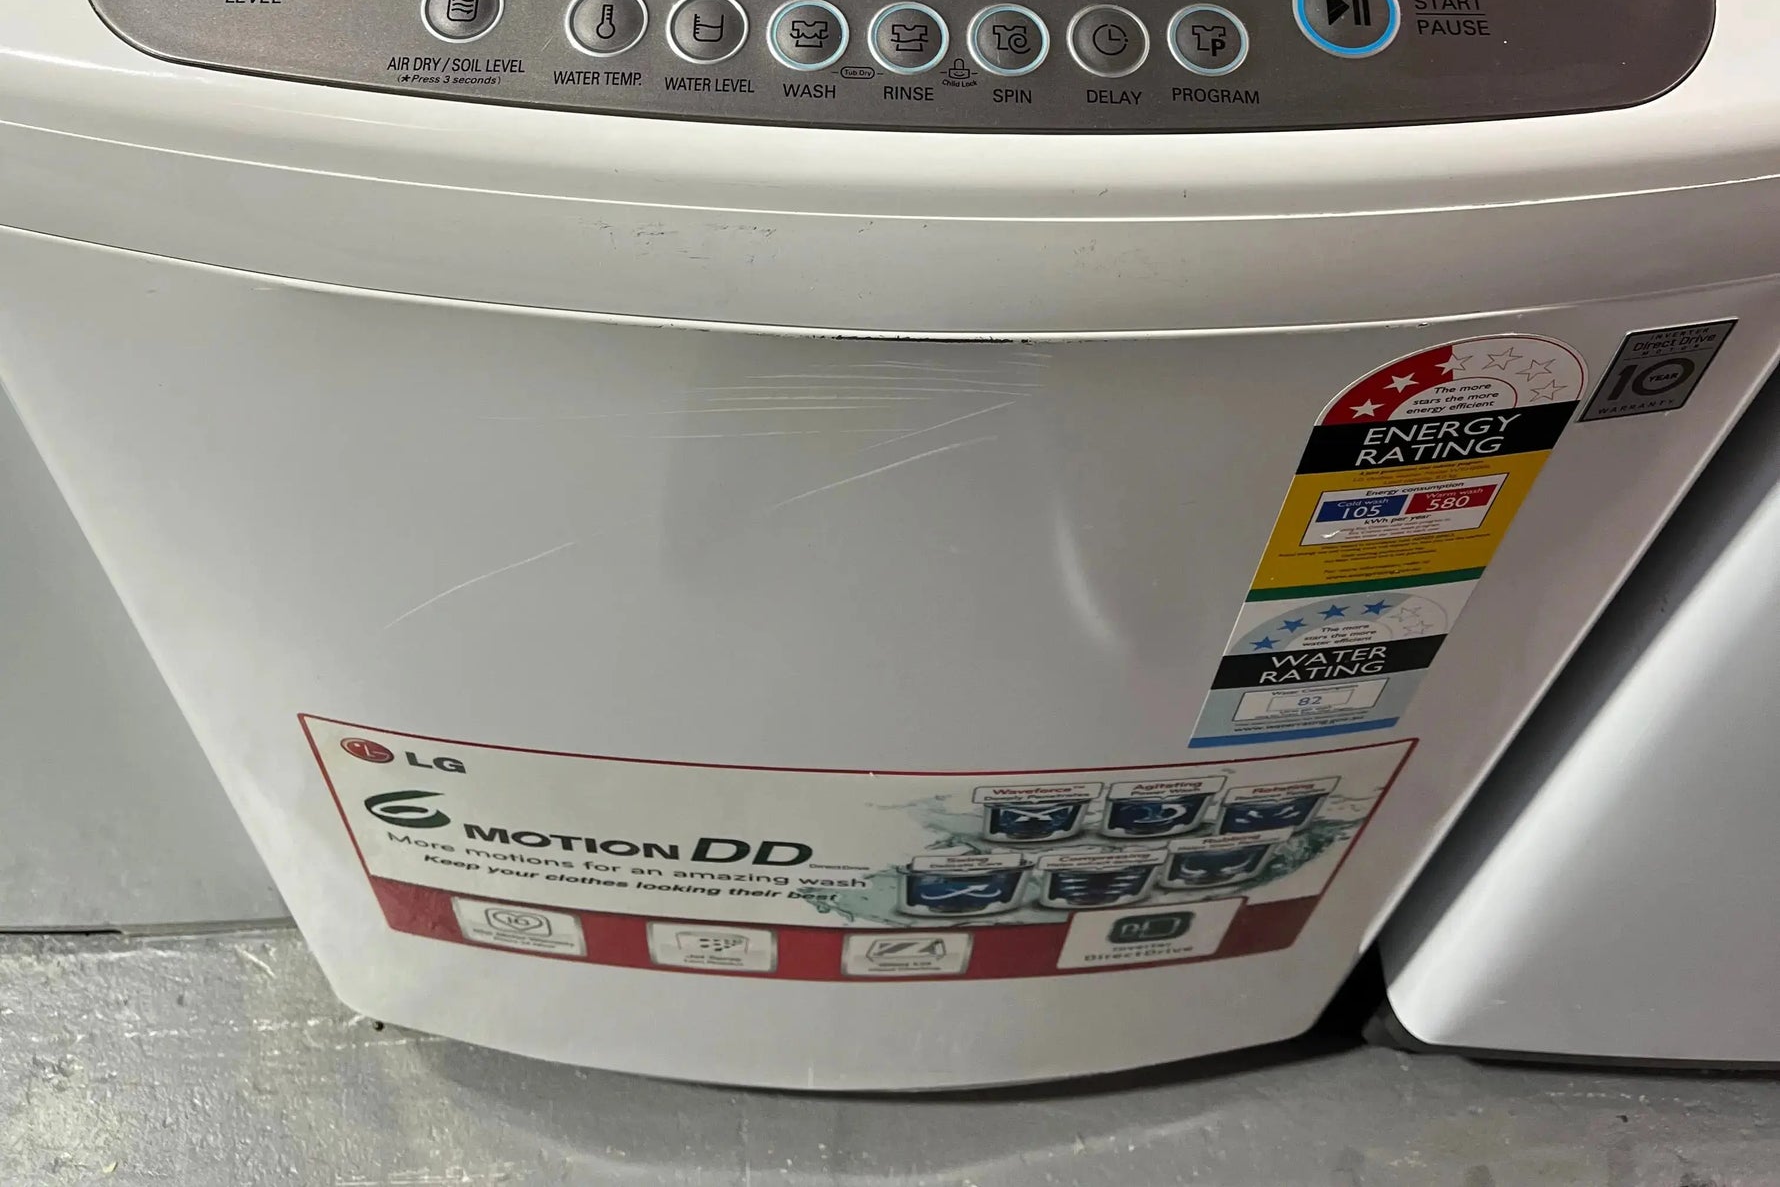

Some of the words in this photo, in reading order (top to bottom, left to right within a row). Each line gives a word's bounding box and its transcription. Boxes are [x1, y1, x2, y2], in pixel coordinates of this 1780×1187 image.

[1416, 19, 1491, 36] PAUSE
[387, 57, 411, 72] AIR
[413, 57, 440, 73] DRY
[452, 58, 483, 73] SOIL
[485, 59, 526, 74] LEVEL
[844, 68, 858, 77] Tub
[858, 68, 872, 79] Dry
[443, 75, 451, 84] 3
[553, 70, 600, 86] WATER
[603, 71, 642, 87] TEMP.
[664, 76, 712, 92] WATER
[714, 77, 755, 94] LEVEL
[942, 78, 960, 88] Child
[961, 78, 978, 88] Lock
[782, 83, 836, 99] WASH
[883, 85, 935, 102] RINSE
[992, 88, 1033, 105] SPIN
[1086, 89, 1143, 106] DELAY
[1171, 87, 1260, 105] PROGRAM
[1650, 327, 1710, 340] INVERTER
[1632, 340, 1677, 352] Direct
[1678, 333, 1717, 346] Drive
[1649, 372, 1679, 383] YEAR
[1434, 386, 1457, 395] The
[1461, 382, 1492, 392] more
[1413, 397, 1441, 406] stars
[1445, 394, 1464, 403] the
[1467, 391, 1499, 400] more
[1406, 405, 1446, 415] energy
[1449, 399, 1495, 411] efficient
[1598, 399, 1674, 415] WARRANTY
[1363, 413, 1522, 446] ENERGY
[1355, 436, 1505, 467] RATING
[1365, 489, 1400, 497] Energy
[1401, 481, 1465, 493] consumption
[1425, 491, 1457, 500] Warm
[1337, 500, 1362, 508] Cold
[1425, 495, 1470, 511] 580
[1342, 504, 1382, 519] 105
[1364, 517, 1389, 525] kWh
[1390, 515, 1409, 524] per
[1410, 514, 1432, 522] year
[1271, 646, 1387, 668] WATER
[1259, 660, 1386, 684] RATING
[1297, 696, 1323, 706] 82
[405, 751, 467, 774] LG
[463, 823, 680, 861] MOTION
[690, 837, 813, 866] DD
[387, 832, 455, 852] More
[465, 848, 574, 869] motions
[584, 861, 620, 873] for
[631, 866, 663, 876] an
[673, 870, 789, 886] amazing
[798, 877, 867, 888] wash
[424, 854, 480, 871] Keep
[487, 866, 540, 880] your
[545, 873, 629, 888] clothes
[636, 882, 721, 897] looking
[728, 888, 782, 899] their
[787, 891, 837, 902] best
